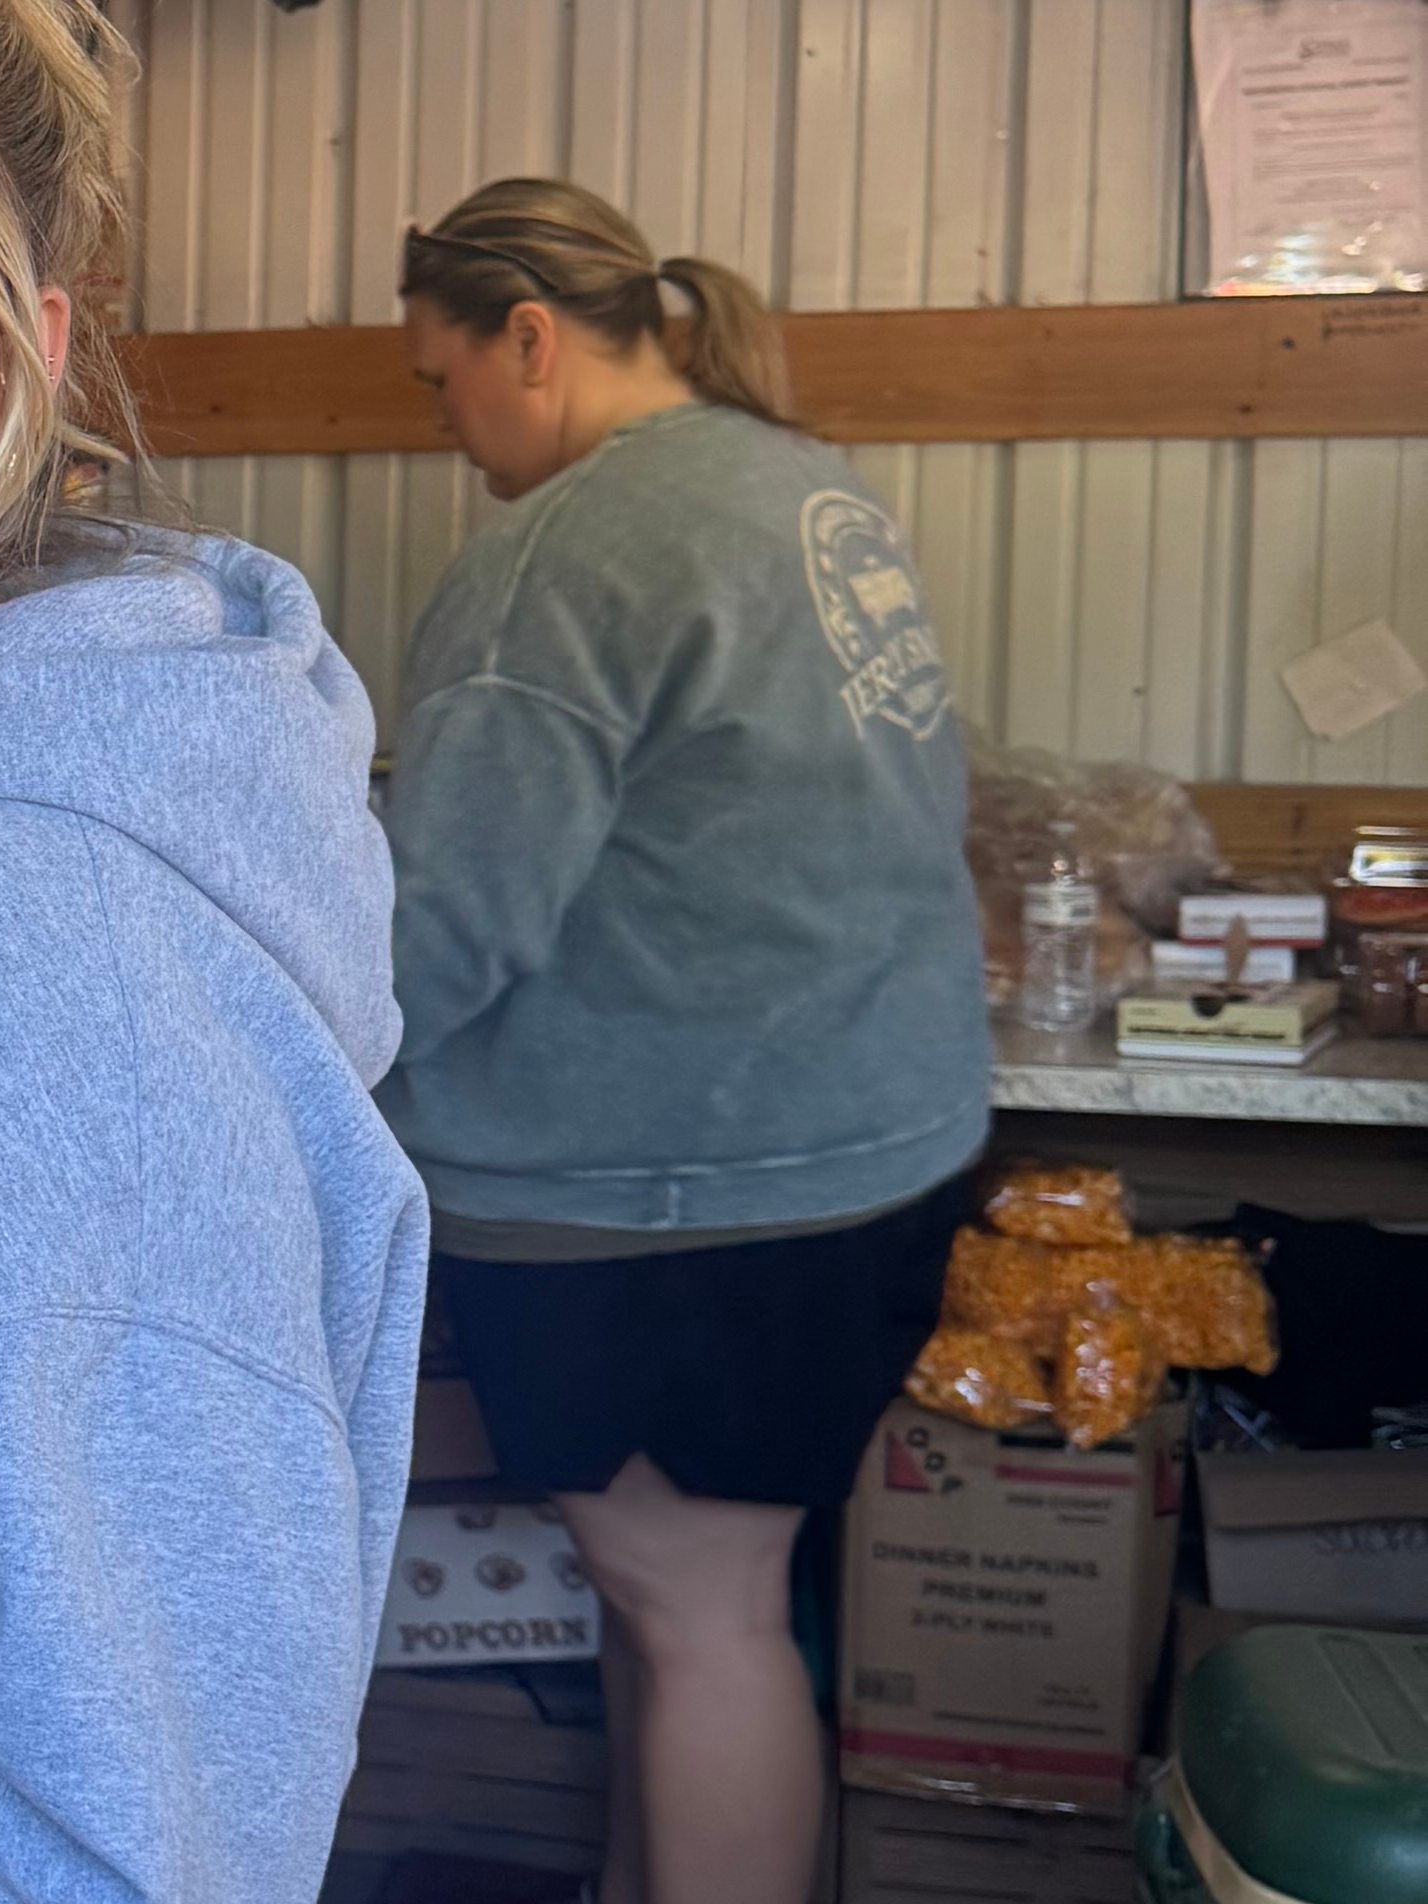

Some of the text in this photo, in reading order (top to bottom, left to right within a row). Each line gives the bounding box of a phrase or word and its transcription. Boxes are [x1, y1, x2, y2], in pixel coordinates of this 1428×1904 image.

[871, 1541, 1099, 1579] DINNER NAPKINS
[921, 1578, 1047, 1607] PREMIUM
[398, 1616, 587, 1653] POPCORN
[981, 1610, 1055, 1640] WHITE
